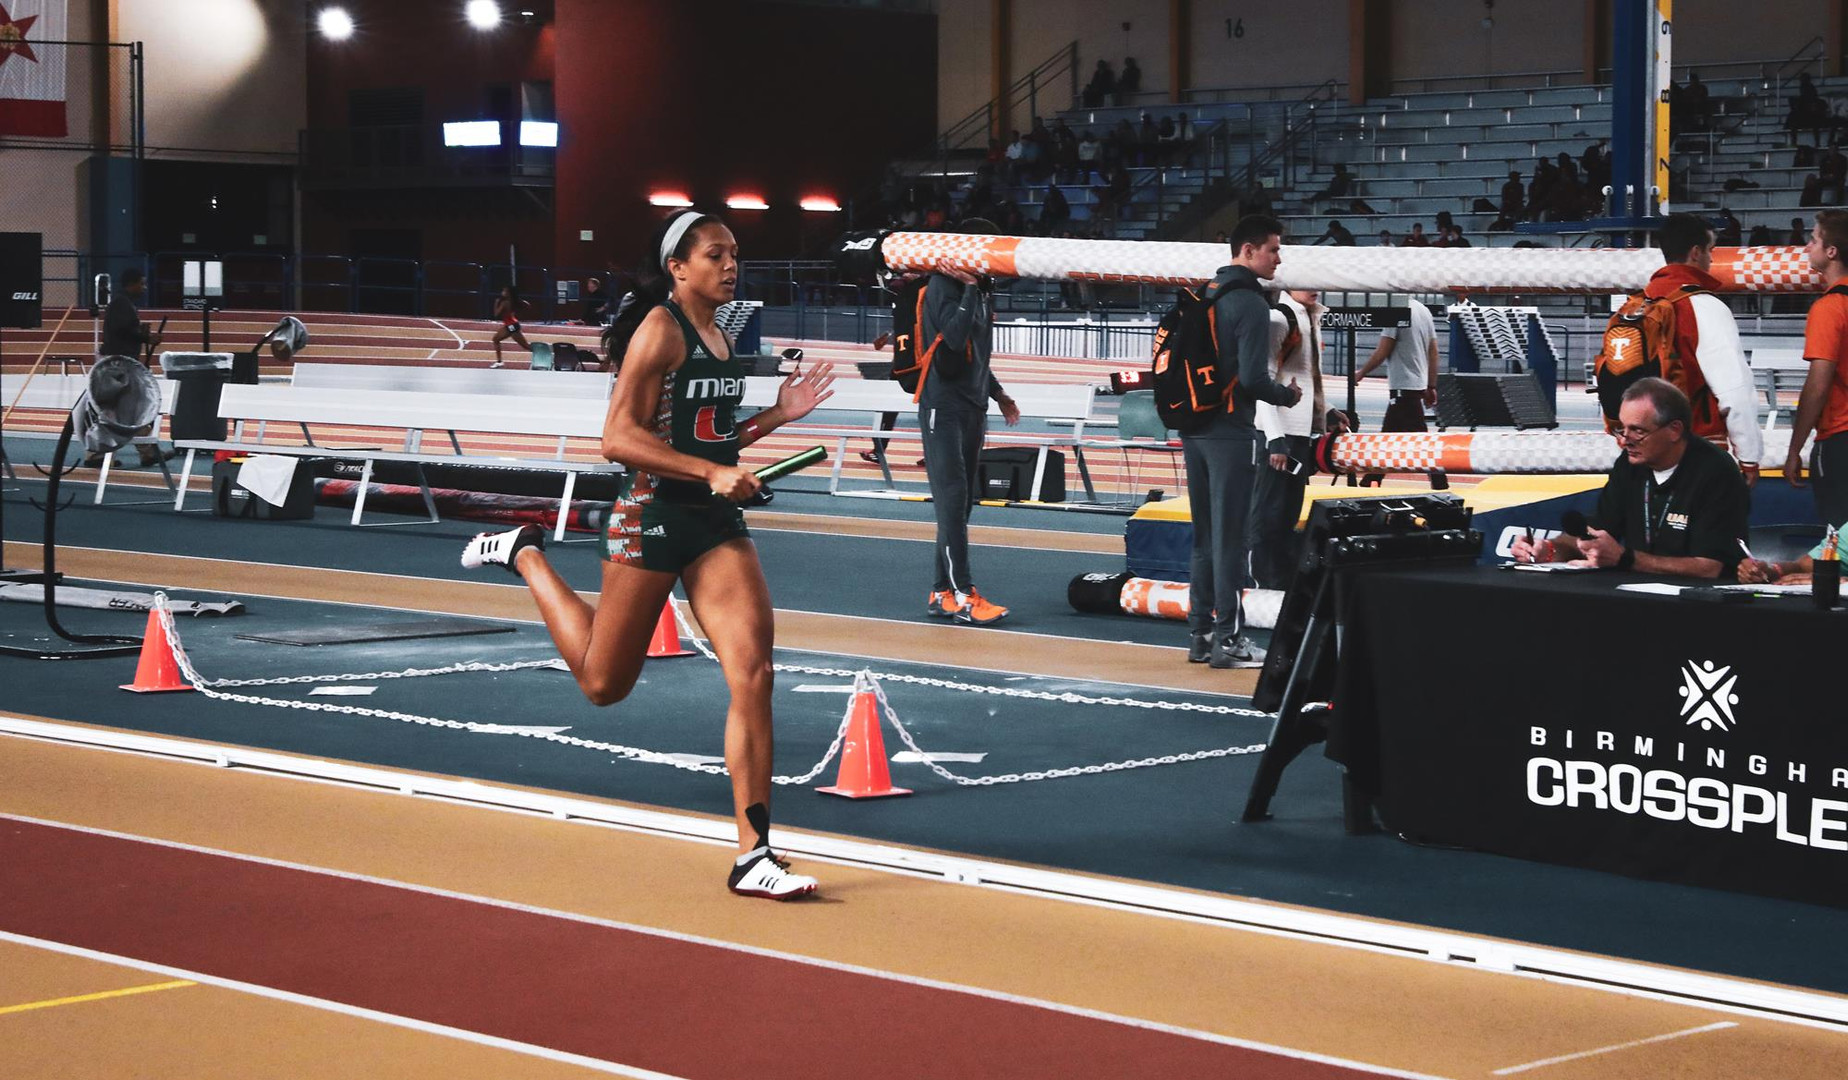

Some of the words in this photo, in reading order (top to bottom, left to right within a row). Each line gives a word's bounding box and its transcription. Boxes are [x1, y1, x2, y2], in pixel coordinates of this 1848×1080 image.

[1225, 18, 1244, 39] 16
[12, 292, 38, 300] GILL
[1320, 313, 1373, 327] FORMANCE
[897, 334, 909, 351] T
[1611, 338, 1630, 360] T
[1197, 365, 1215, 386] T
[1530, 726, 1848, 788] BIRMINGHA
[1527, 757, 1848, 851] CROSSPLE
